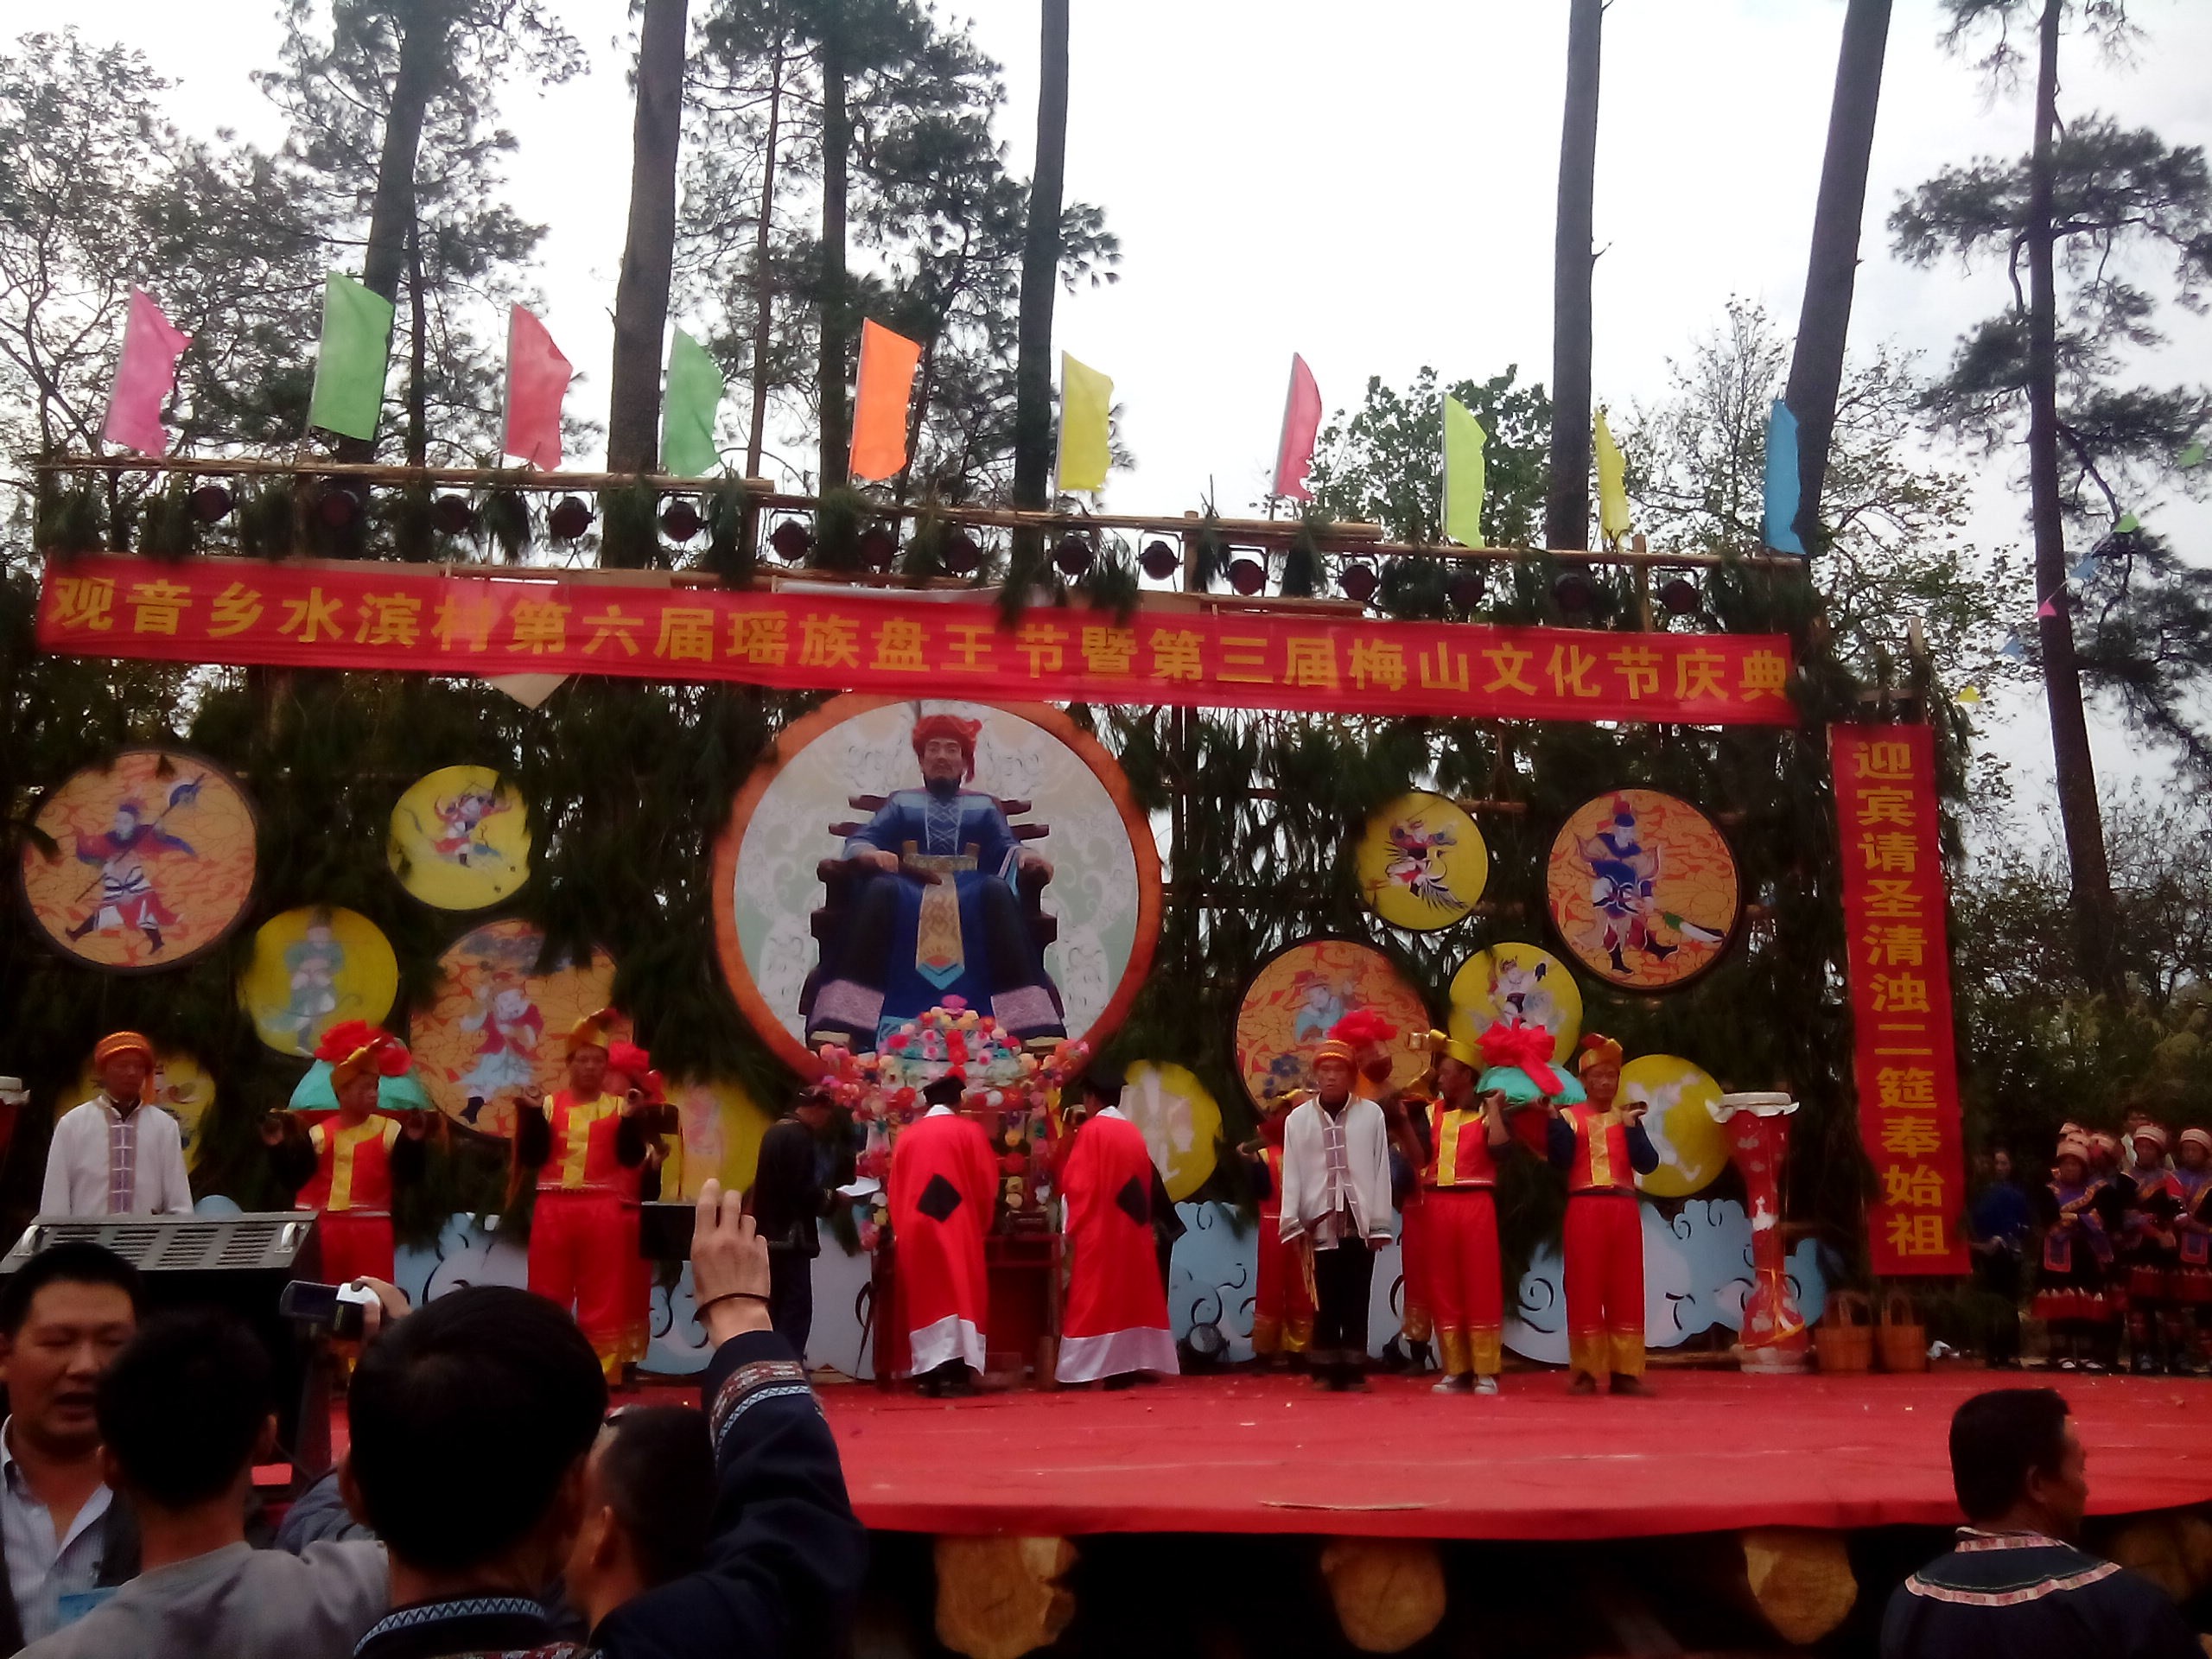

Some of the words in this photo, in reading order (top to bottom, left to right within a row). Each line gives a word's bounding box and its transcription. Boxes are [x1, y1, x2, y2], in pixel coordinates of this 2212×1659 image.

[49, 577, 1787, 702] 观音乡水滨村第六届瑶族盘王节暨第三届梅山文化节庆典
[1853, 742, 1949, 1255] 迎宾请圣清浊二筵奉始祖
